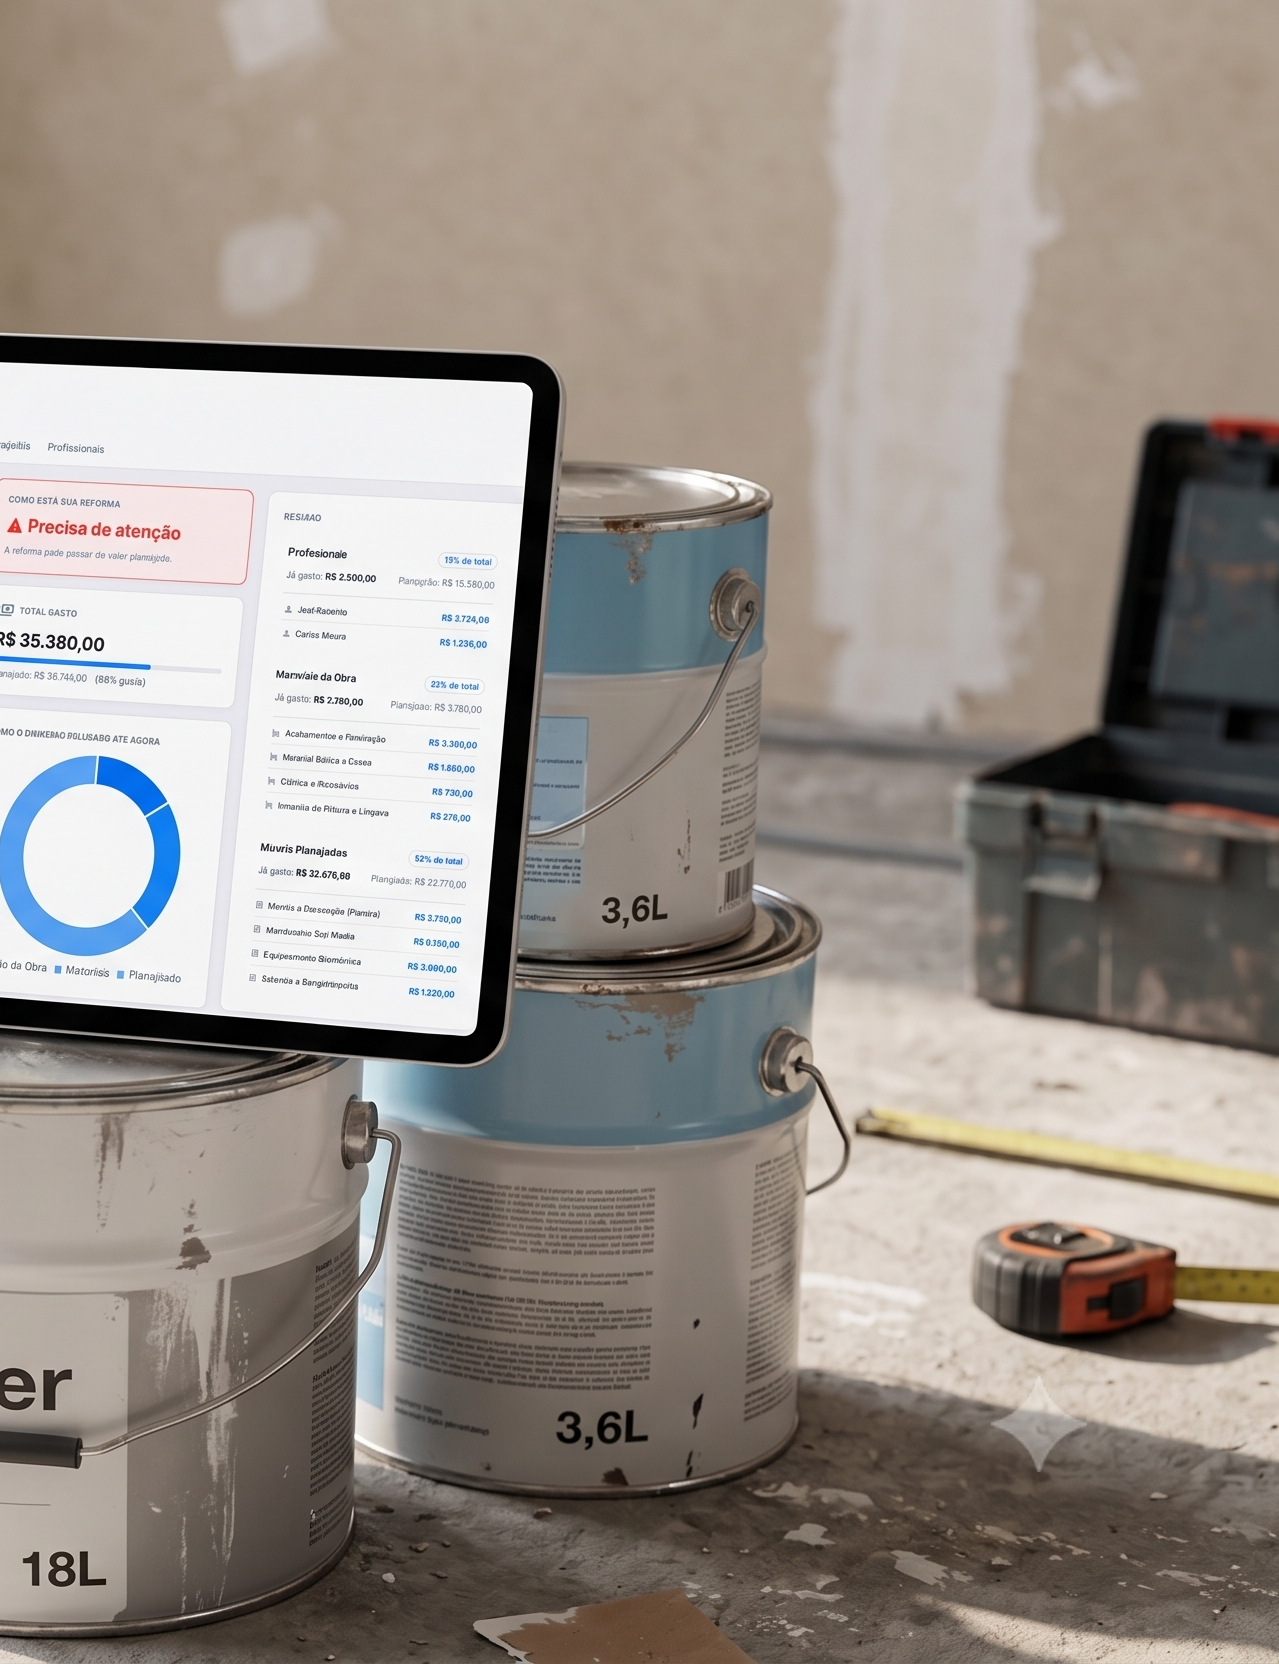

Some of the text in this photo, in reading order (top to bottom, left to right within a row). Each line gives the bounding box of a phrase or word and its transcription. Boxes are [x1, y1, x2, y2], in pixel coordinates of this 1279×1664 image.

[48, 443, 104, 453] Profissionais
[9, 496, 34, 504] COMO
[61, 498, 77, 506] SUA
[80, 499, 120, 508] REFORMA
[28, 519, 181, 543] Precisa de atenção
[339, 573, 376, 583] 2.500,00
[20, 607, 77, 617] TOTAL GASTO
[20, 633, 104, 653] 35.380,00
[334, 673, 356, 682] Obra
[130, 736, 160, 745] AGORA
[602, 894, 668, 929] 3,6L
[25, 962, 47, 972] Obra
[556, 1410, 648, 1450] 3,6L
[23, 1551, 106, 1587] 18L
